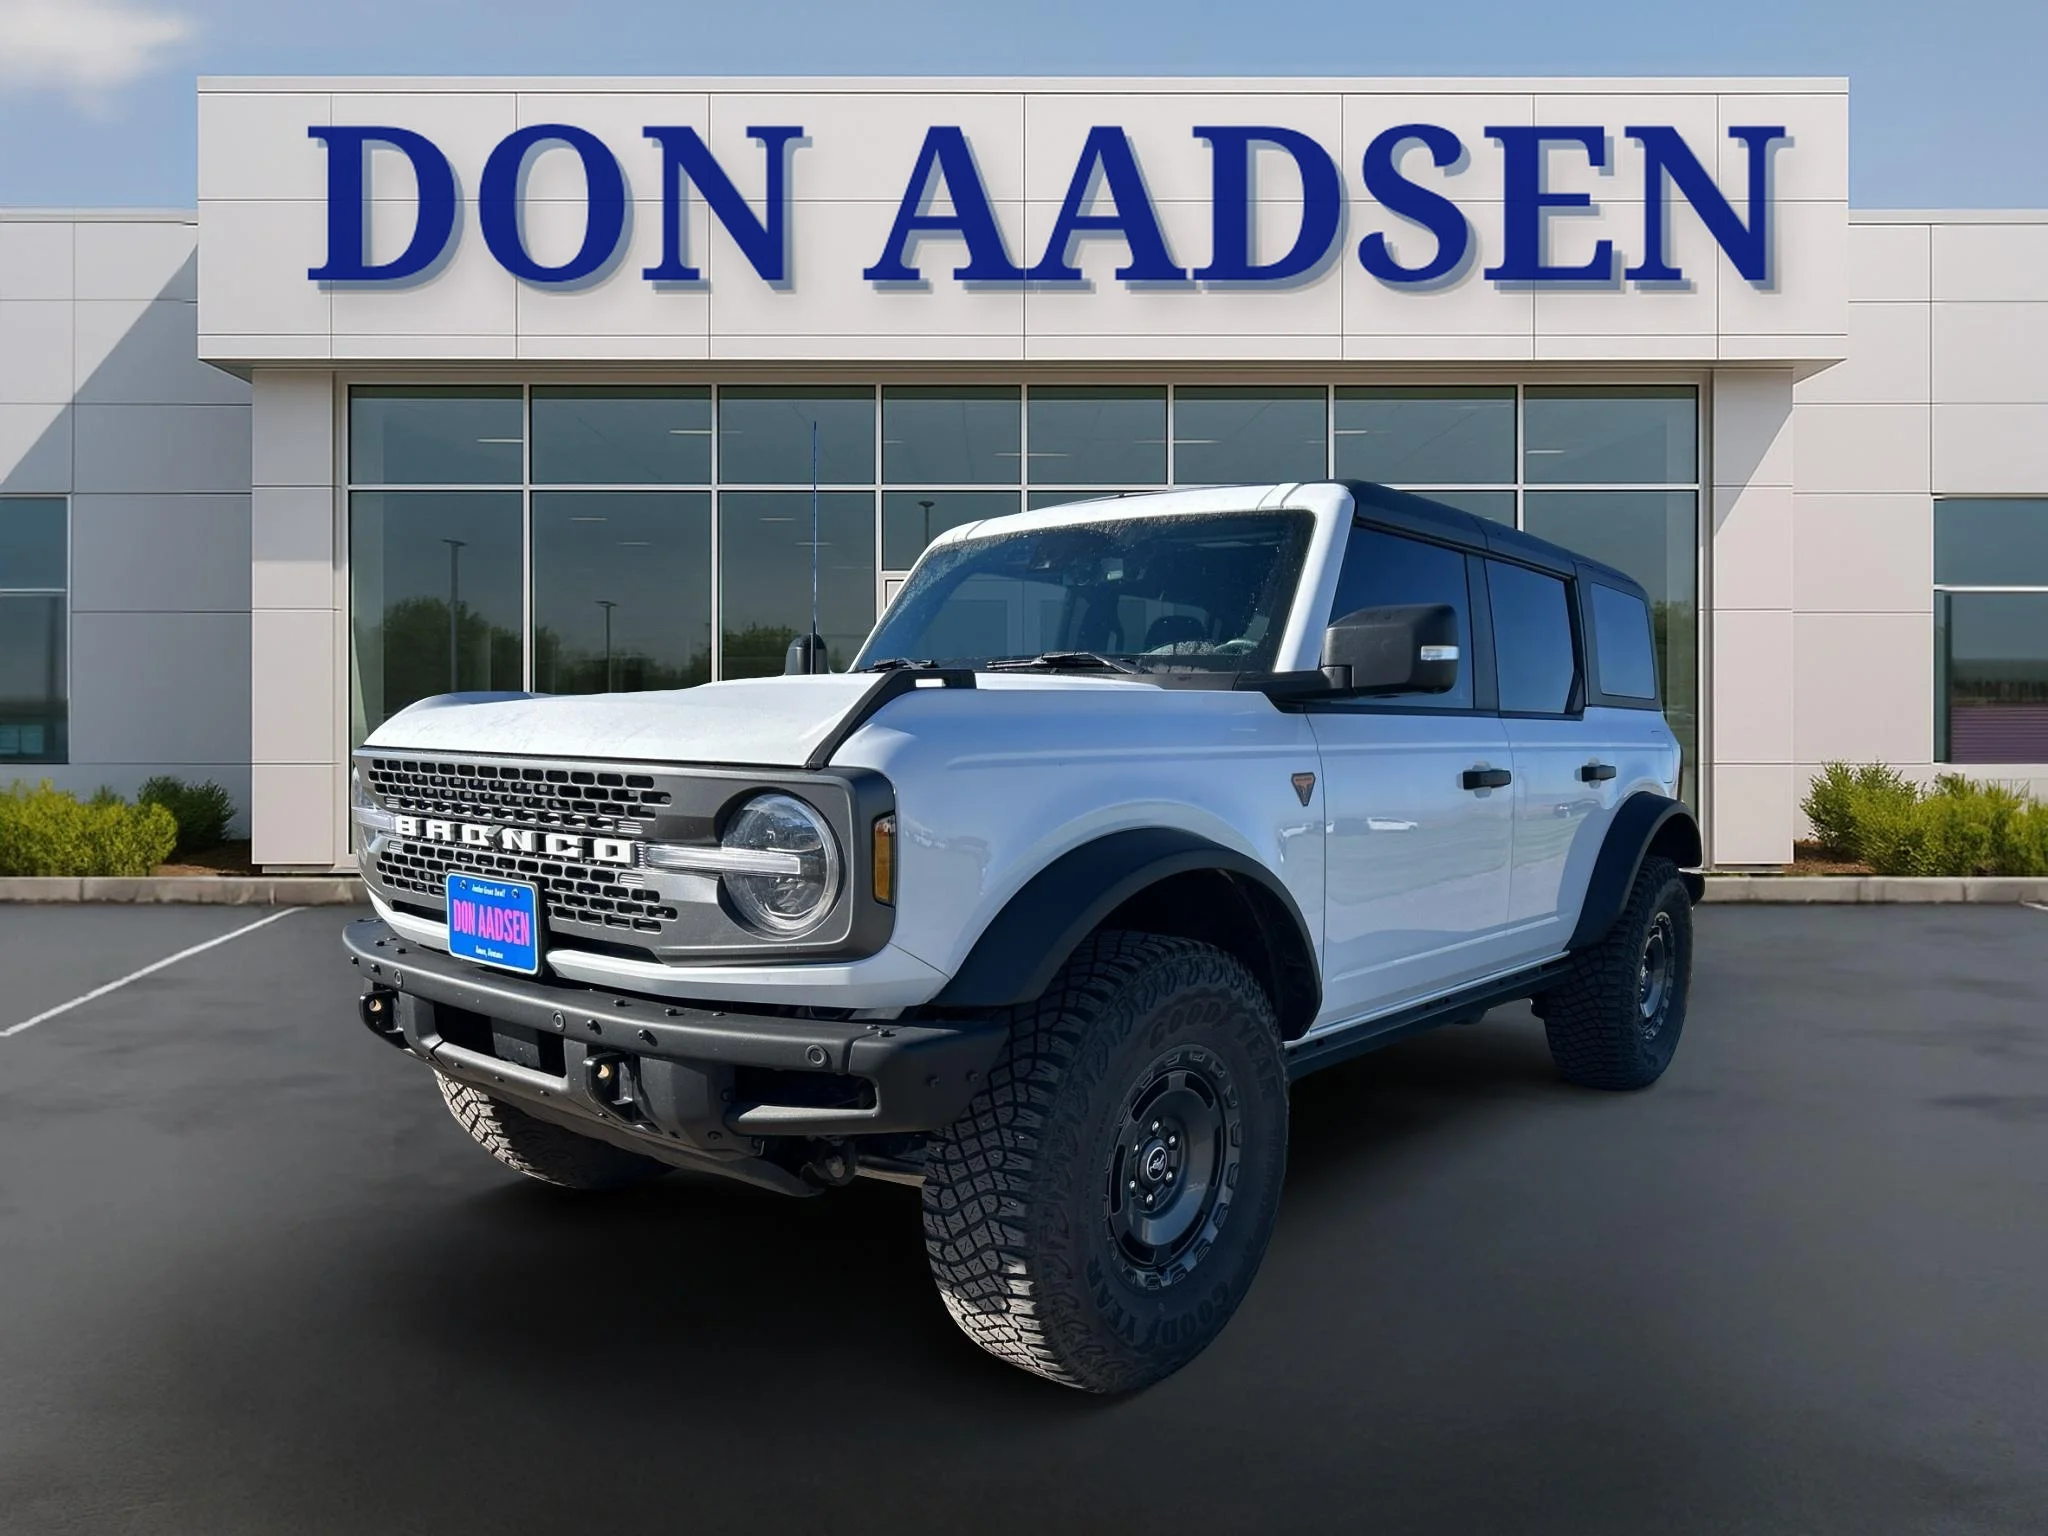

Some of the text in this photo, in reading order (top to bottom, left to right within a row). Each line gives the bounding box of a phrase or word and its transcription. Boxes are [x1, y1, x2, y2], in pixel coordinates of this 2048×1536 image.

[307, 123, 1787, 283] DON AADSEN
[395, 815, 636, 864] BRONCO
[453, 898, 530, 947] DON AADSEN
